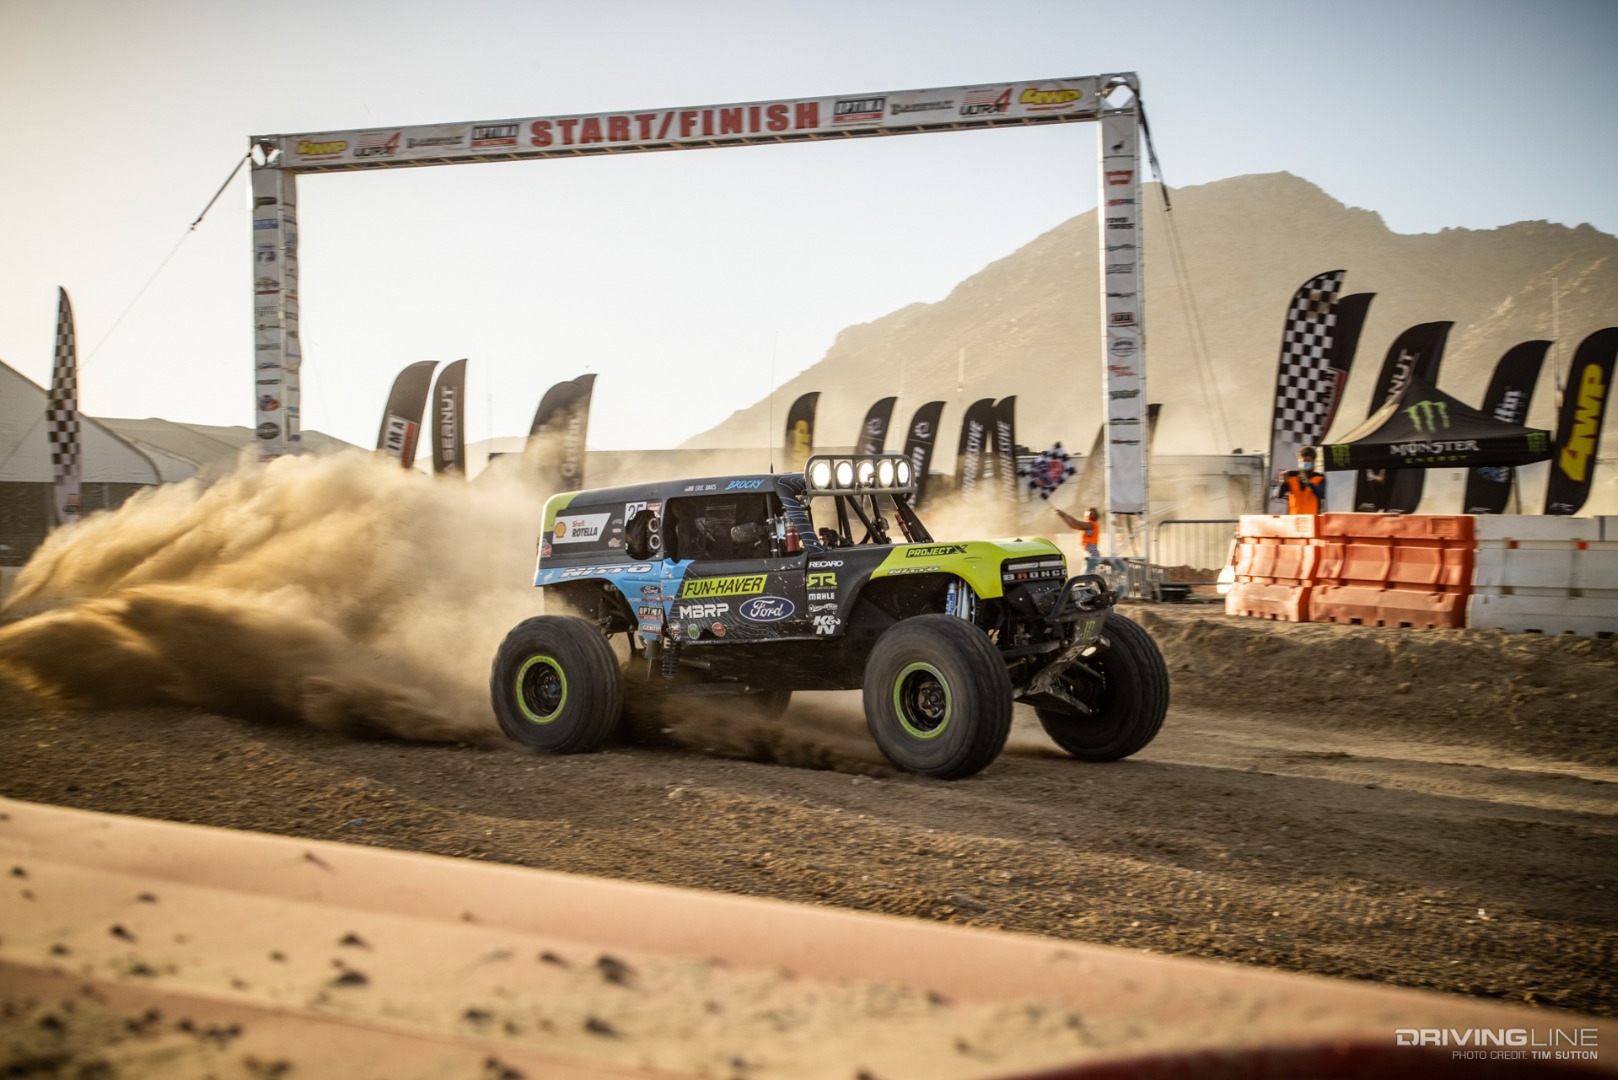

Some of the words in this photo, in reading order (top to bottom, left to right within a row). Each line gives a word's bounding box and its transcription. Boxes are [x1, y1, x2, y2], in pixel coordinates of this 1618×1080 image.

[1559, 365, 1606, 482] 4WP
[1390, 440, 1480, 456] MONSTER
[572, 527, 598, 538] ROTELLA
[559, 563, 653, 578] NITTO
[808, 560, 844, 568] RECARO
[684, 577, 764, 596] FUN-HAVER
[808, 592, 835, 600] MAHLE
[679, 603, 729, 619] MBRP
[749, 599, 784, 618] Ford
